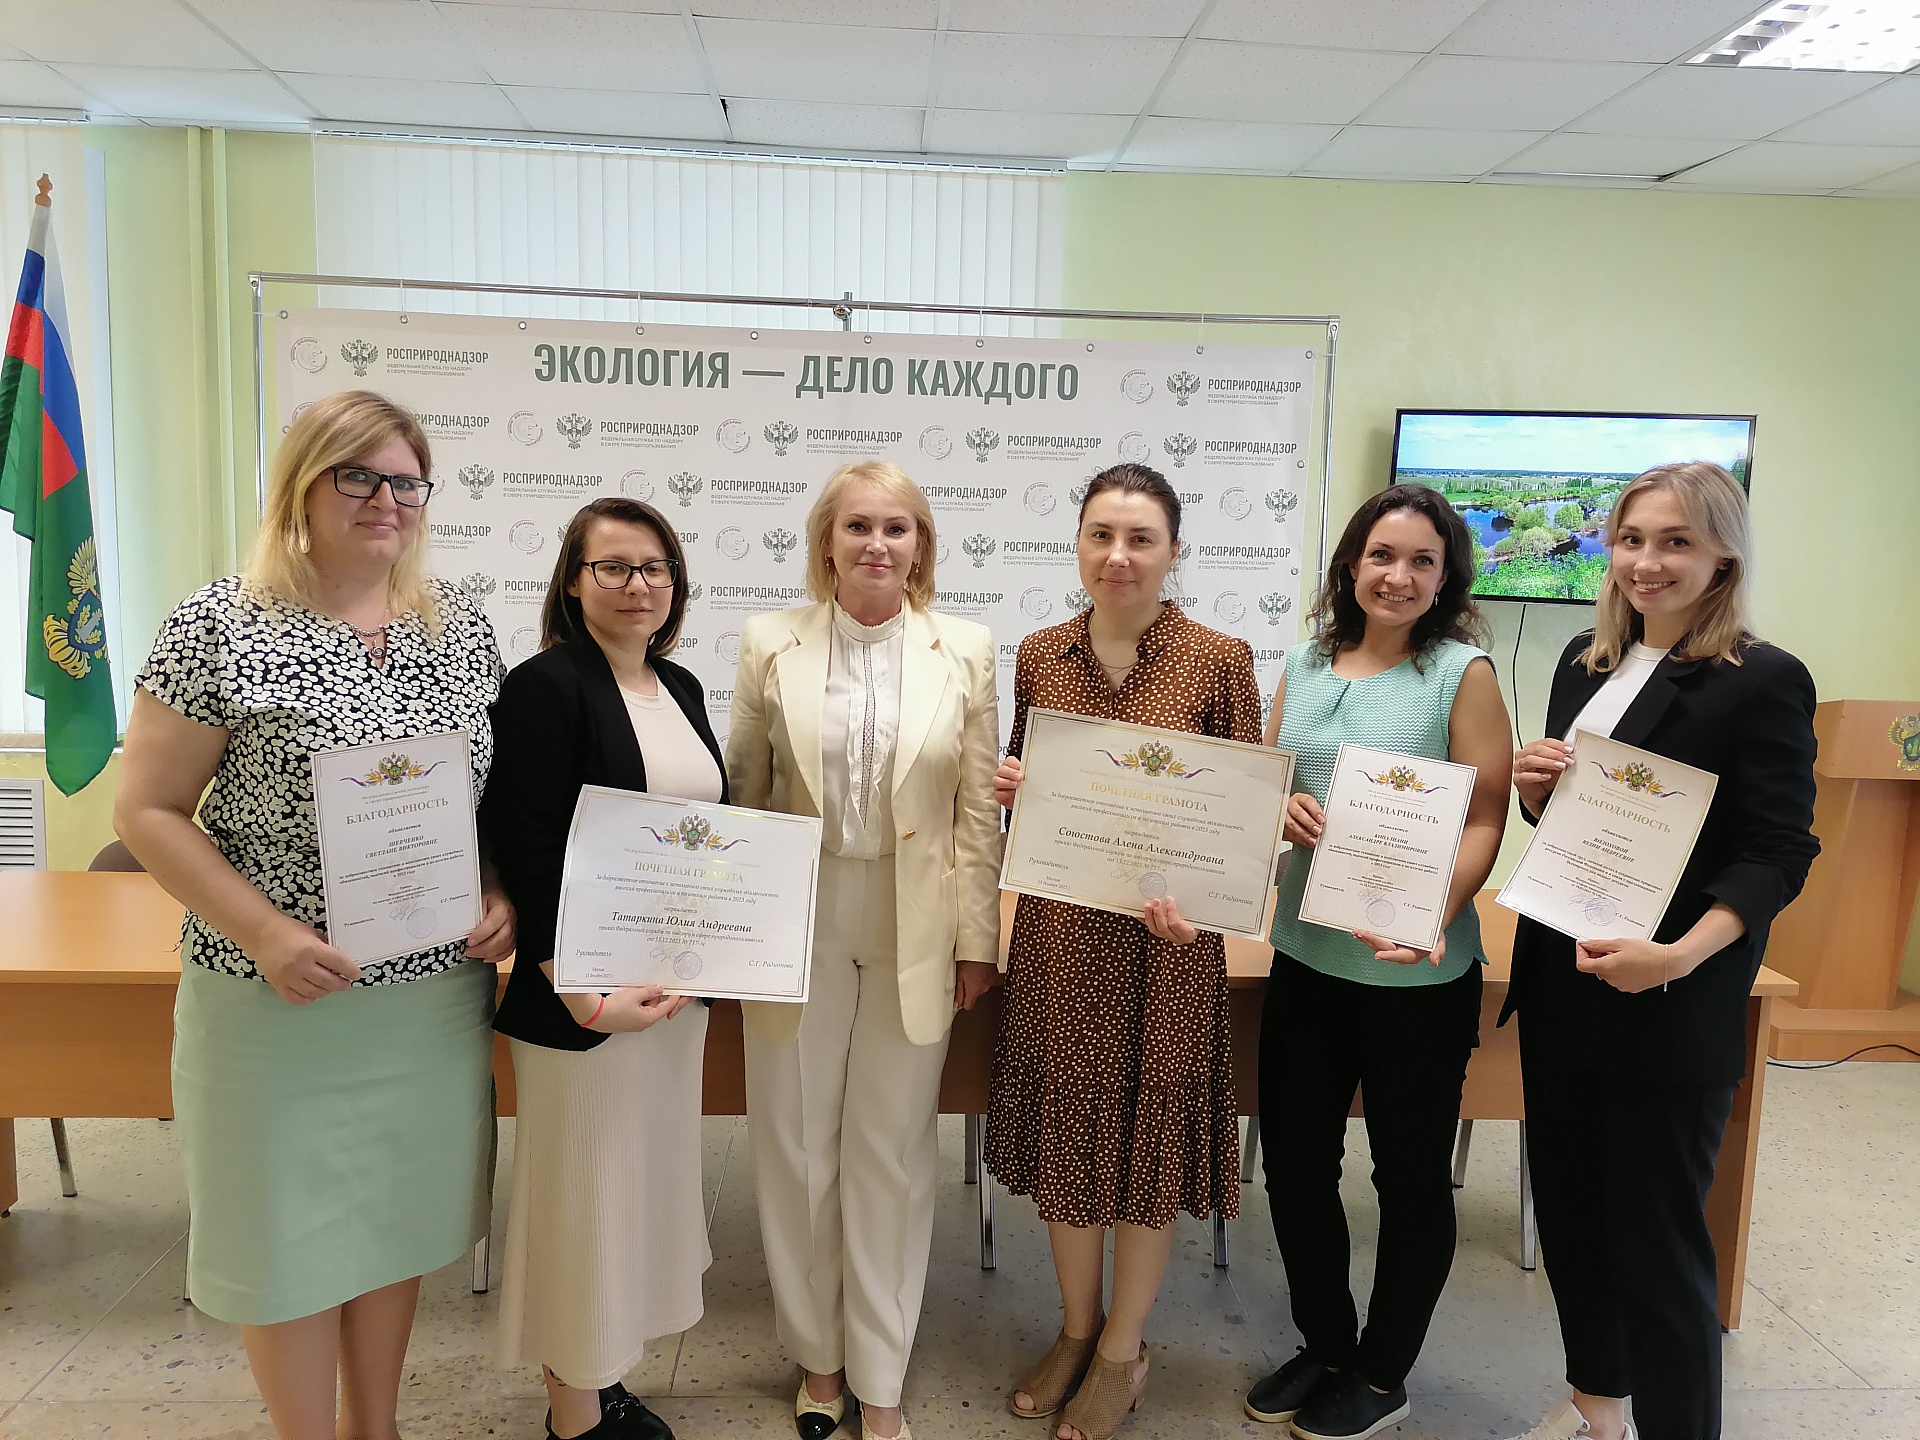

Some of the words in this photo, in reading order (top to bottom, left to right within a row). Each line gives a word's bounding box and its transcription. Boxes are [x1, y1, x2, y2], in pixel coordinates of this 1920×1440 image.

[386, 348, 489, 364] РОСПРИРОДНАДЗОР
[534, 343, 730, 389] ЭКОЛОГИЯ
[796, 353, 893, 399] ДЕЛО
[907, 358, 1079, 406] КАЖДОГО
[1208, 378, 1301, 393] РОСПРИРОДНАДЗОР
[601, 421, 699, 436] РОСПРИРОДНАДЗОР
[806, 428, 902, 443] РОСПРИРОДНАДЗОР
[1007, 435, 1101, 449] РОСПРИРОДНАДЗОР
[1205, 440, 1297, 455] РОСПРИРОДНАДЗОР
[503, 472, 602, 487] РОСПРИРОДНАДЗОР
[711, 479, 808, 494] РОСПРИРОДНАДЗОР
[1199, 546, 1291, 559] РОСПРИРОДНАДЗОР
[710, 586, 806, 599] РОСПРИРОДНАДЗОР
[1089, 781, 1152, 802] ПОЧЕТНАЯ
[1154, 793, 1209, 812] ГРАМОТА
[346, 797, 448, 825] БЛАГОДАРНОСТЬ
[1348, 799, 1439, 824] БЛАГОДАРНОСТЬ
[1577, 793, 1671, 833] БЛАГОДАРНОСТЬ
[1195, 825, 1208, 833] 2023
[365, 846, 397, 858] СВЕТЛАНЕ
[398, 838, 438, 851] ВИКТОРОВНЕ
[388, 835, 423, 847] ШЕВЧЕНКО
[1058, 826, 1110, 843] Союстова
[1112, 836, 1143, 850] Алена
[1145, 842, 1224, 867] Александровна
[634, 861, 690, 875] ПОЧЕТНАЯ
[611, 911, 663, 926] Татаркина
[665, 915, 695, 926] Юлия
[697, 919, 752, 934] Андреевна
